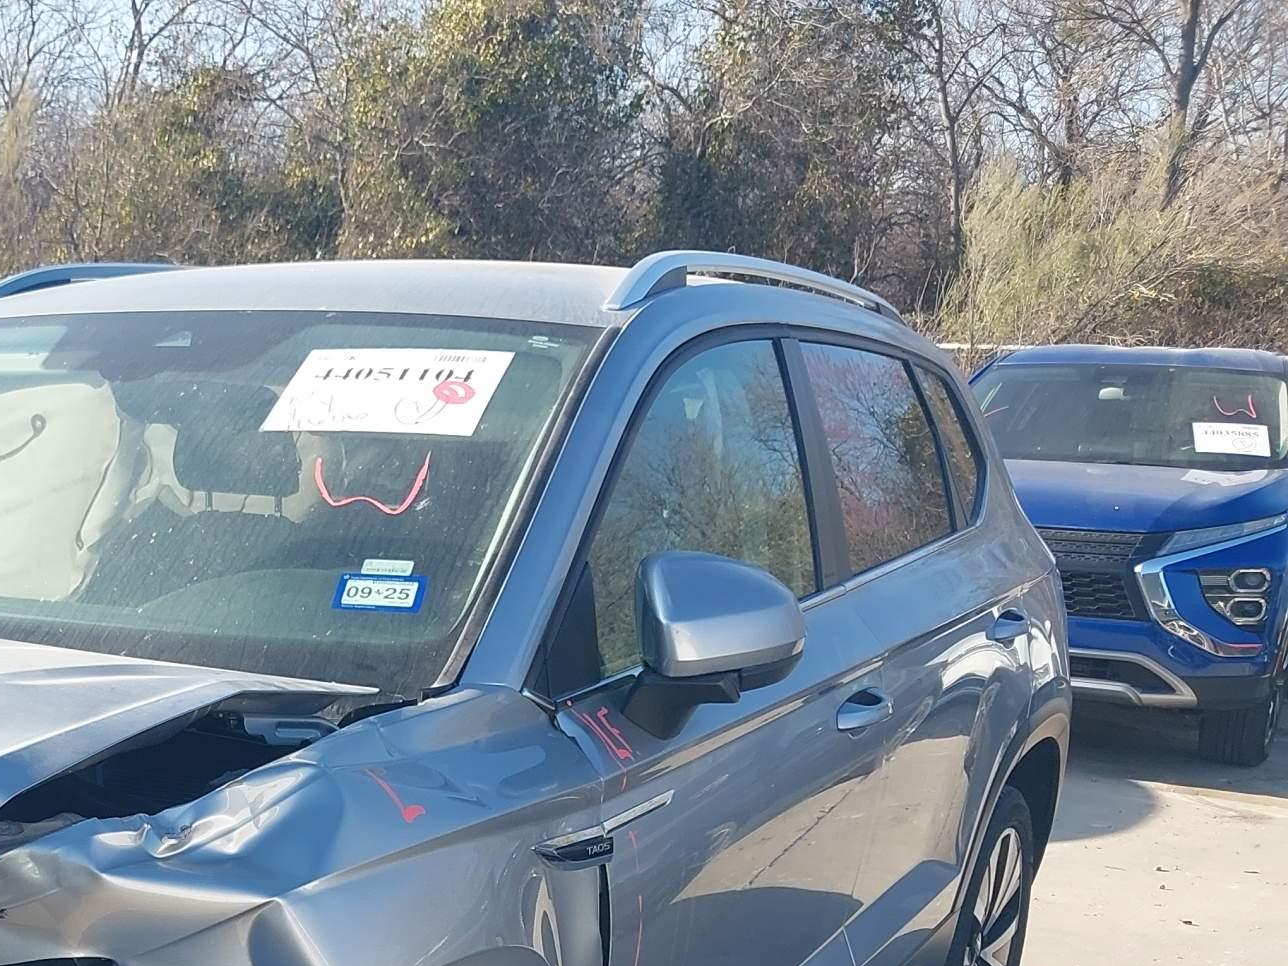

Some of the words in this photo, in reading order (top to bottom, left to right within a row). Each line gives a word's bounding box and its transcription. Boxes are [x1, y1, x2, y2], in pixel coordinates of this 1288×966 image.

[314, 367, 475, 383] 44051104
[346, 586, 372, 599] 09
[383, 587, 411, 600] 25
[586, 842, 611, 856] TAOS
